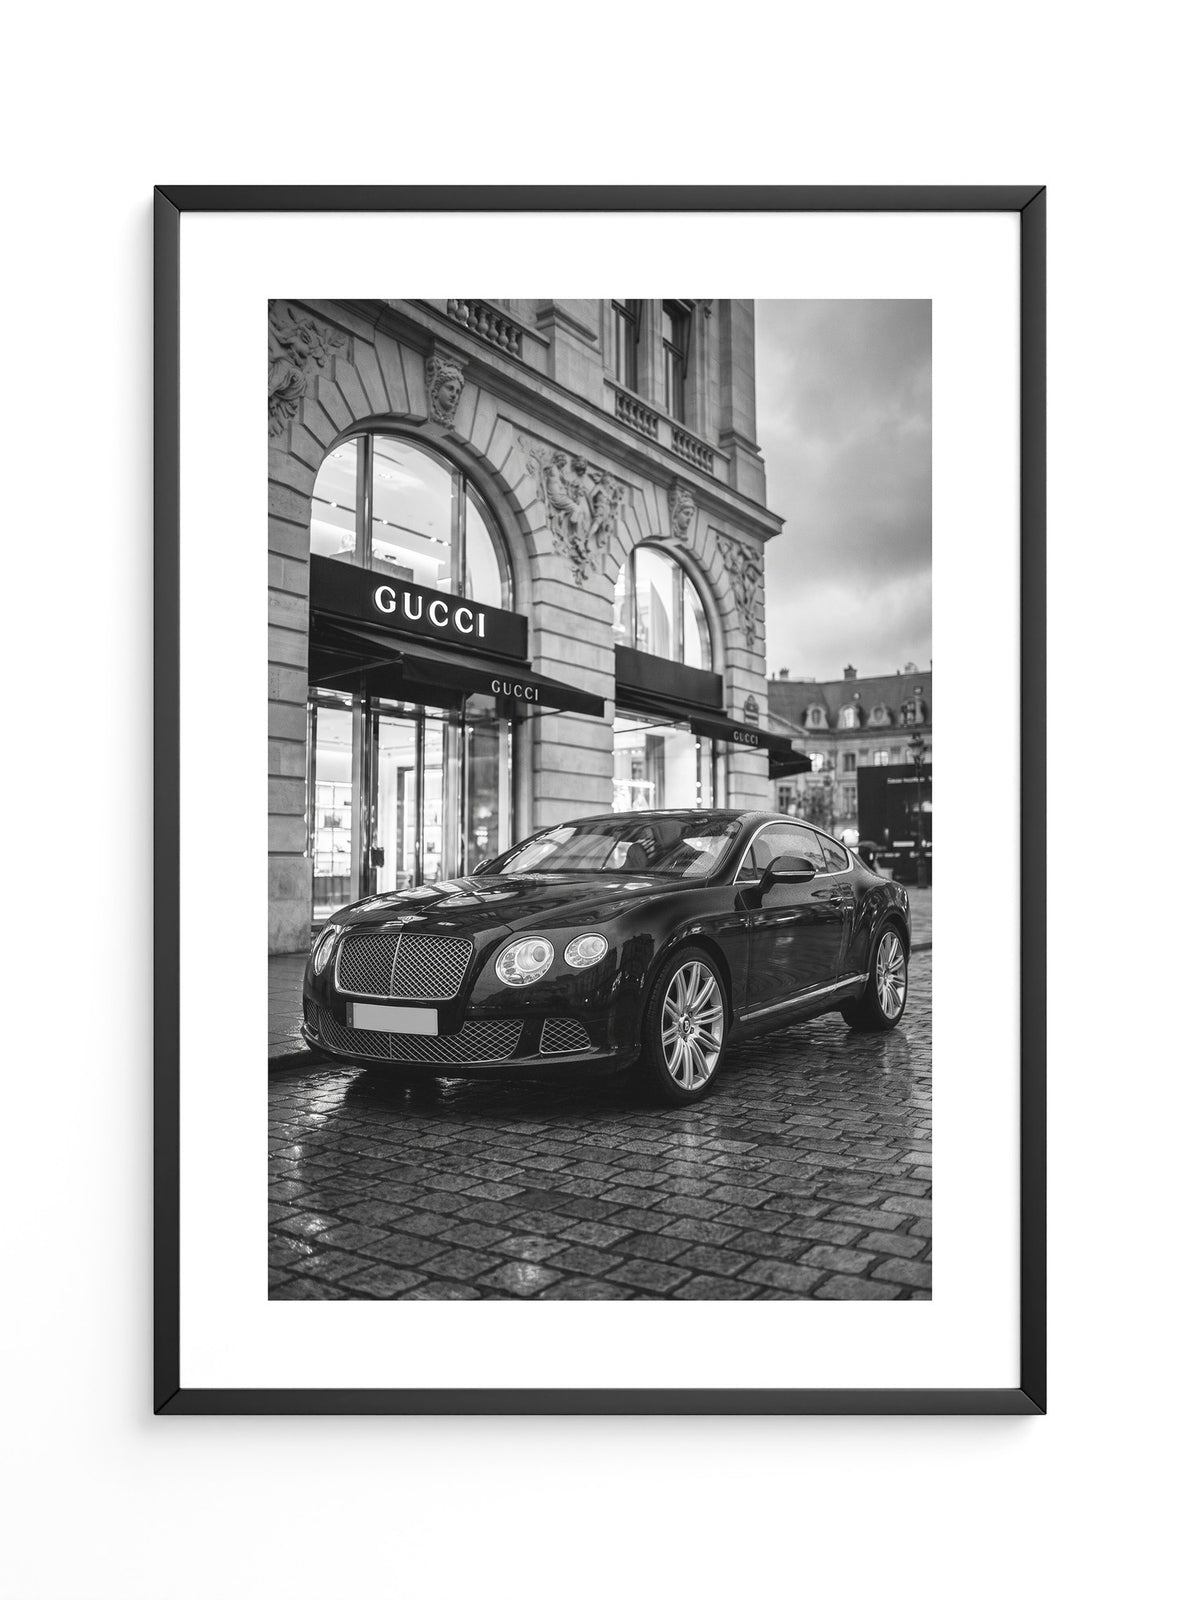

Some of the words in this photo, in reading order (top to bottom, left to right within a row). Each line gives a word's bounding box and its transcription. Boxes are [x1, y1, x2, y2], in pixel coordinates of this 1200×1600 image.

[374, 586, 485, 637] GUCCI
[491, 680, 539, 701] GUCCI
[733, 730, 759, 745] GUCCI
